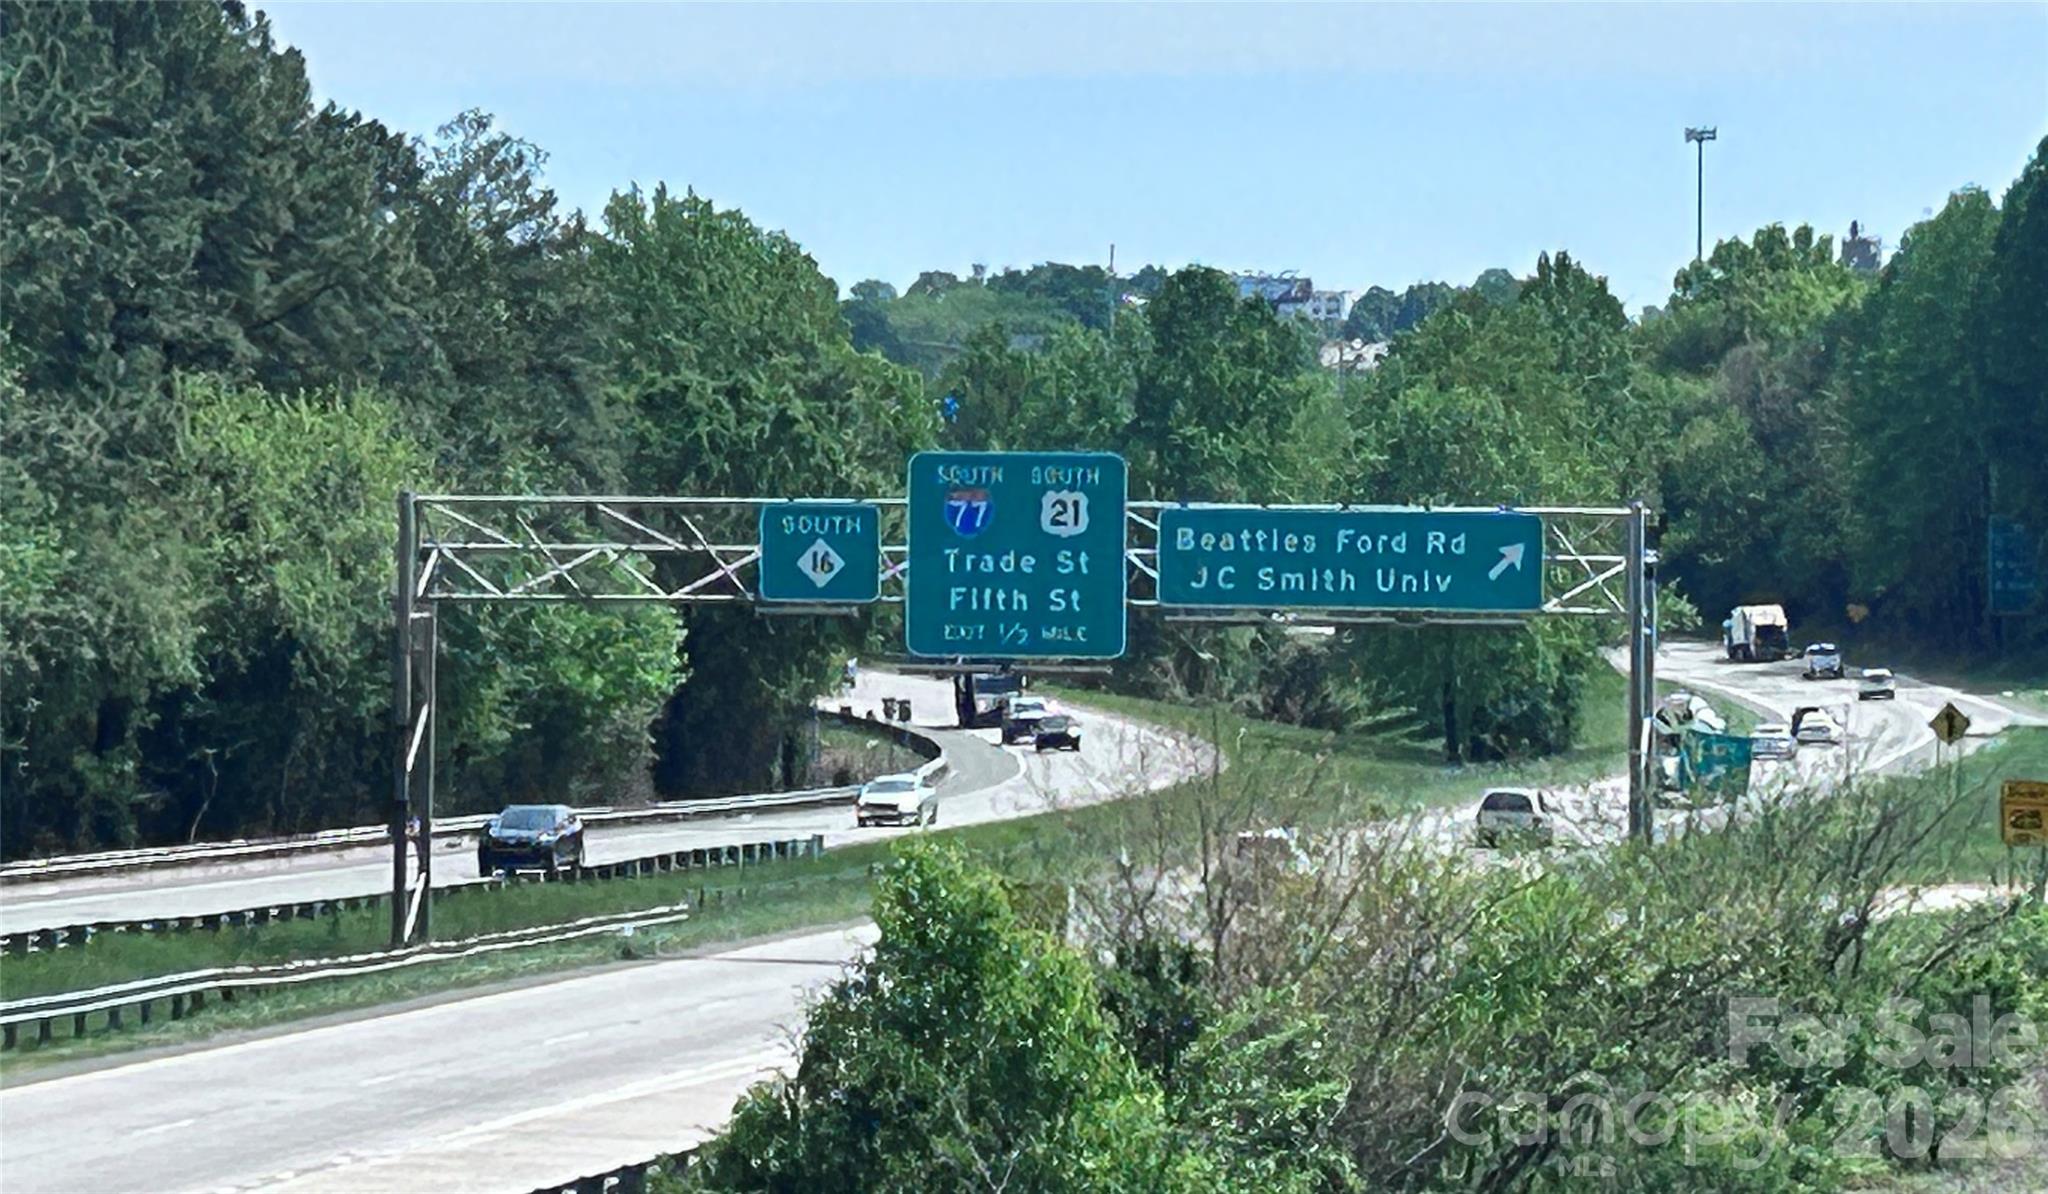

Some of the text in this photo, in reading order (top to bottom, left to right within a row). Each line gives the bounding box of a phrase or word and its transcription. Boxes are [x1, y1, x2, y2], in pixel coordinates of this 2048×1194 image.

[782, 515, 861, 535] SOUTH
[947, 501, 988, 527] 77
[1050, 499, 1080, 527] 21
[1336, 528, 1407, 554] Ford
[1427, 531, 1467, 555] Rd
[811, 551, 835, 574] 16
[944, 548, 1091, 574] Trade St
[1190, 566, 1452, 593] JC Smith Univ
[950, 587, 1081, 612] Fifth St
